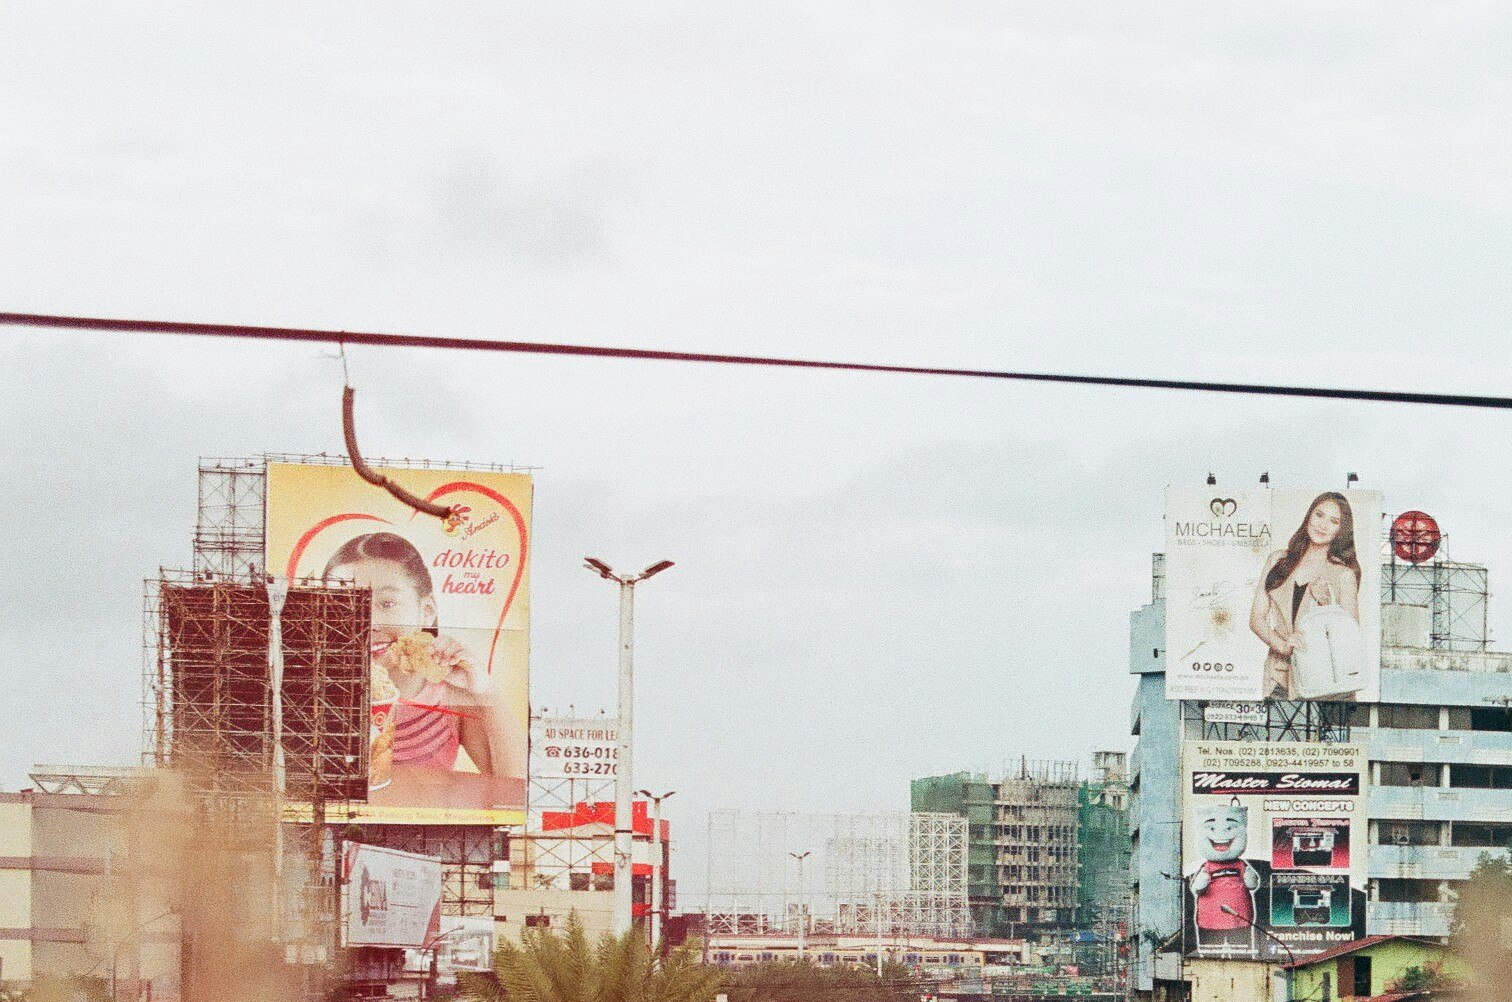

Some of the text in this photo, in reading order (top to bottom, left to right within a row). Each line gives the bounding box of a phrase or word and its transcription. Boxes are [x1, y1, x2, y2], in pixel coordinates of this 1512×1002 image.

[1175, 522, 1272, 538] MICHAELA
[433, 548, 510, 569] dokito
[442, 574, 496, 594] heart
[559, 729, 583, 741] SPACE
[587, 730, 603, 741] FOR
[1302, 747, 1320, 757] (02)
[1194, 773, 1353, 789] Master Siomai
[1263, 800, 1354, 812] NEW CONCEPTS
[1266, 930, 1355, 941] Franchise Now!
